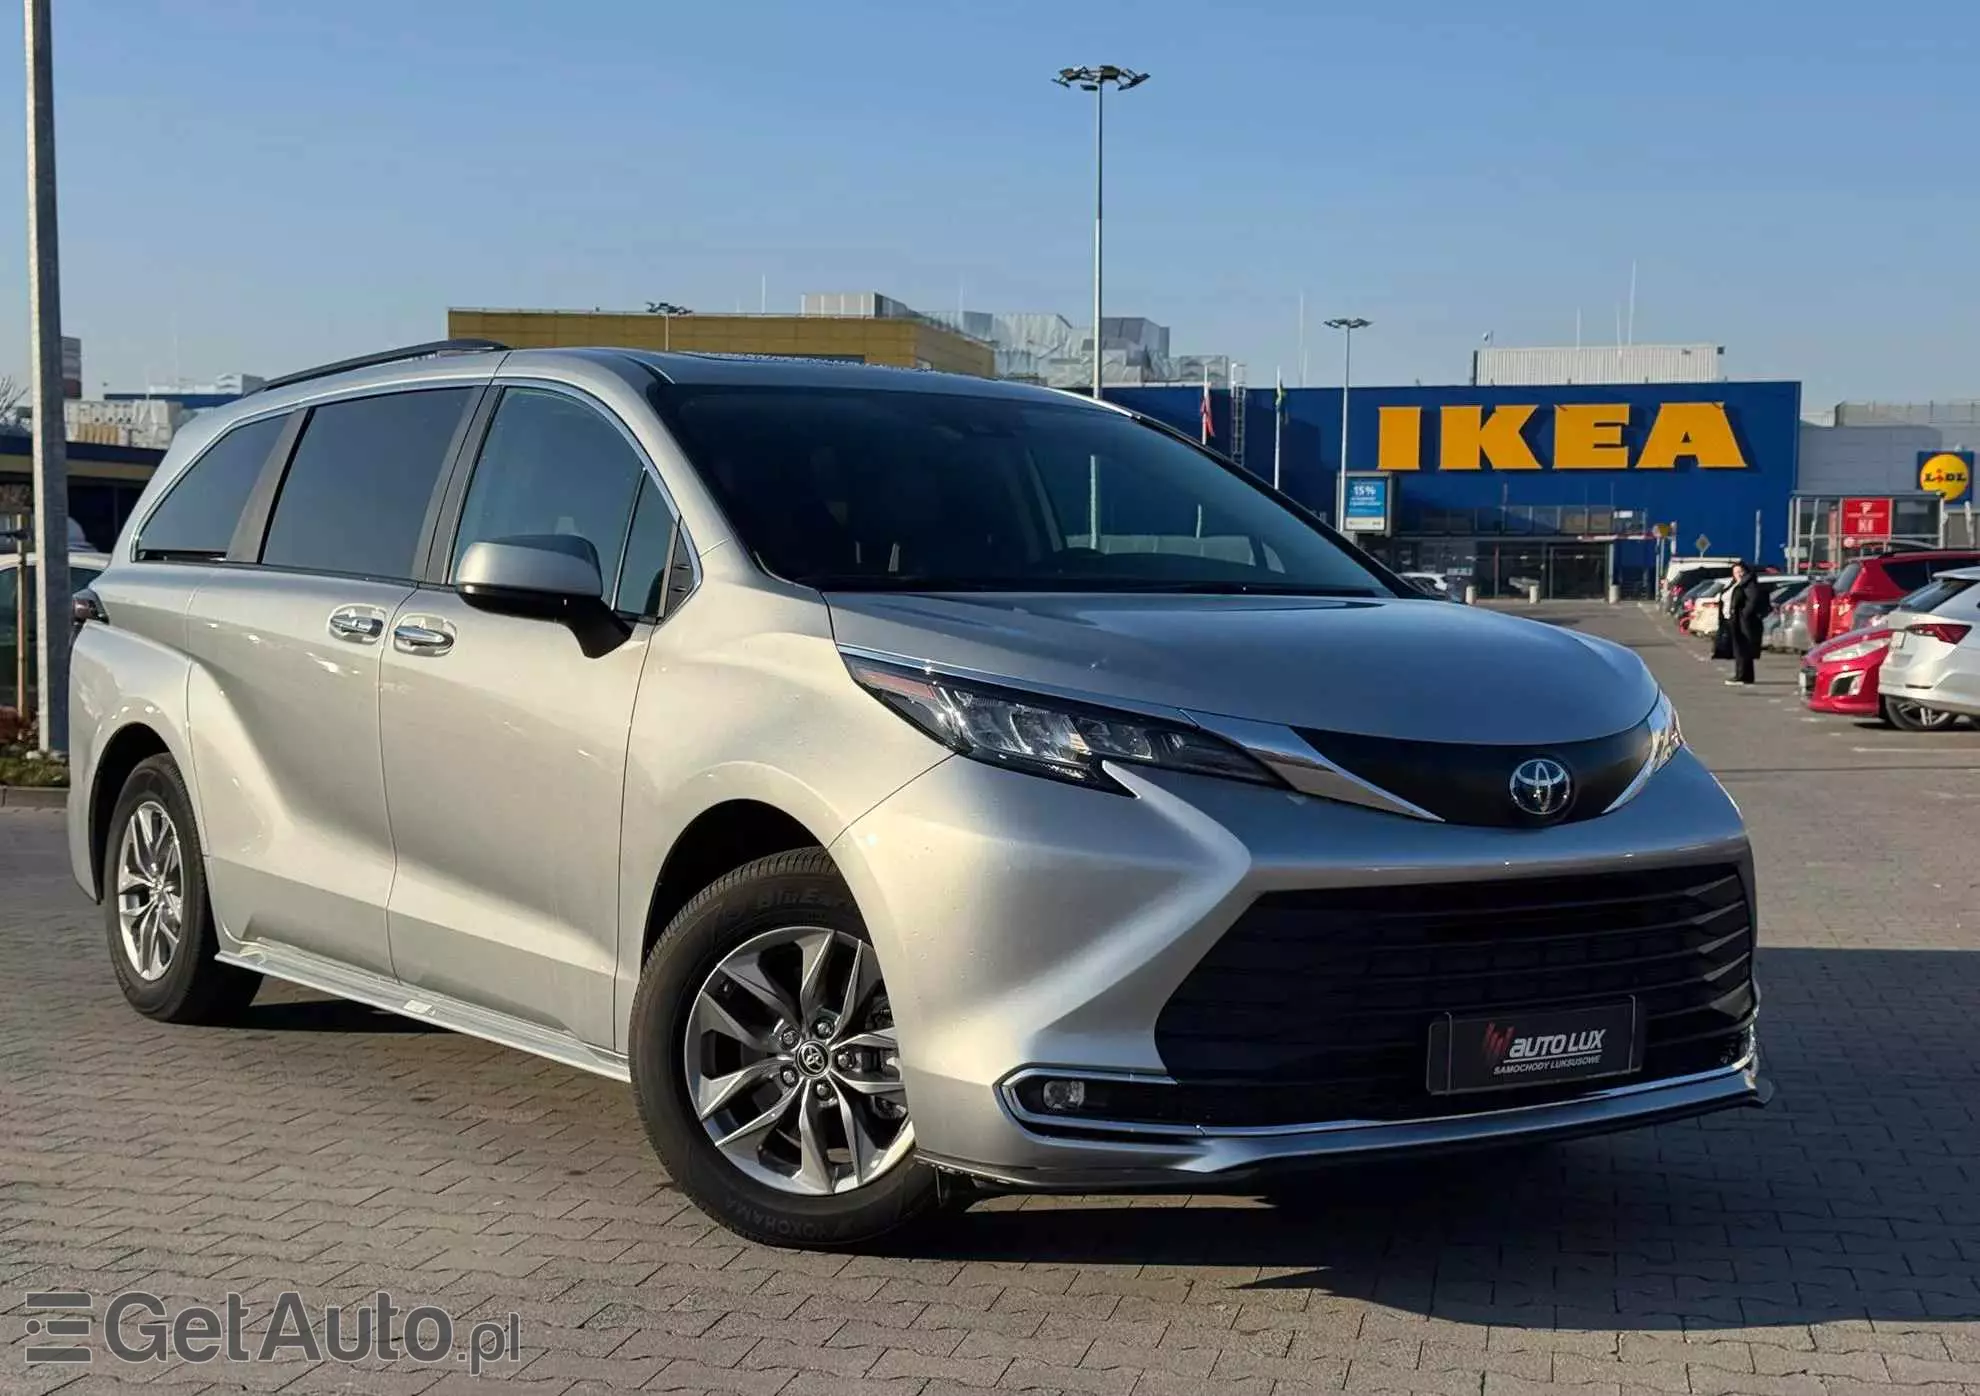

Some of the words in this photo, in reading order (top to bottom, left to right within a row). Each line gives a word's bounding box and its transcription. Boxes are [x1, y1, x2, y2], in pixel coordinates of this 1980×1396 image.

[1378, 401, 1748, 471] IKEA
[1568, 1028, 1607, 1052] LUX
[1493, 1062, 1550, 1075] SAMOCHODY
[1550, 1055, 1602, 1069] LUKSUSOWE
